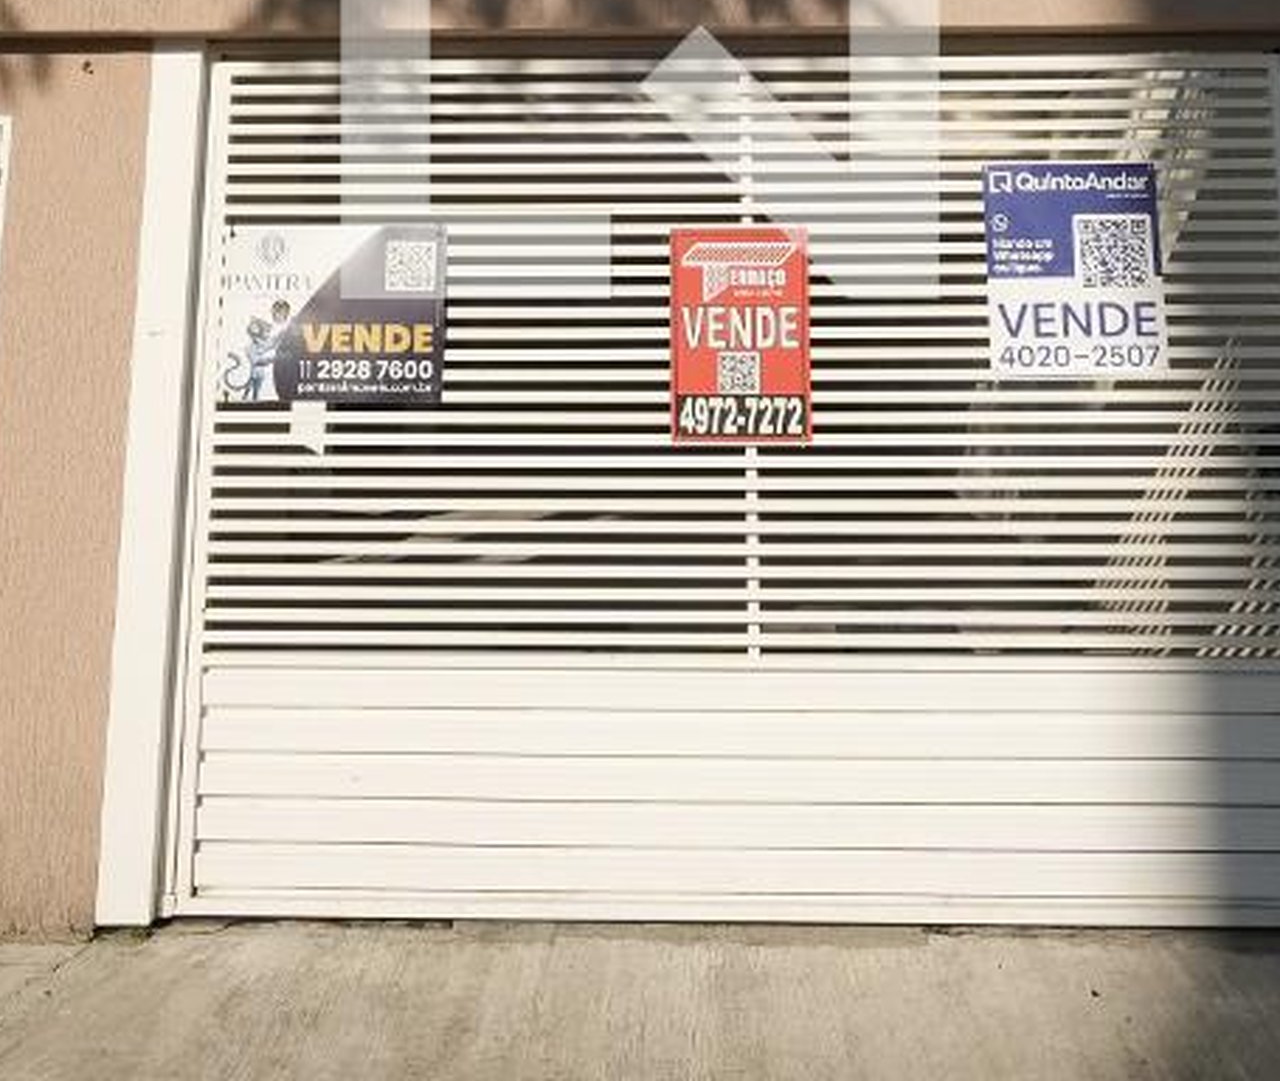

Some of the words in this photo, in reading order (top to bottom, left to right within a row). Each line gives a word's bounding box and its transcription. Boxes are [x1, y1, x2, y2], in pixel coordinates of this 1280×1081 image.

[1015, 171, 1149, 191] QuintoAndar
[681, 306, 800, 350] VENDE
[997, 301, 1159, 338] VENDE
[301, 323, 434, 354] VENDE
[316, 360, 371, 379] 2928
[376, 360, 434, 379] 7600
[680, 396, 803, 435] 4972-7272
